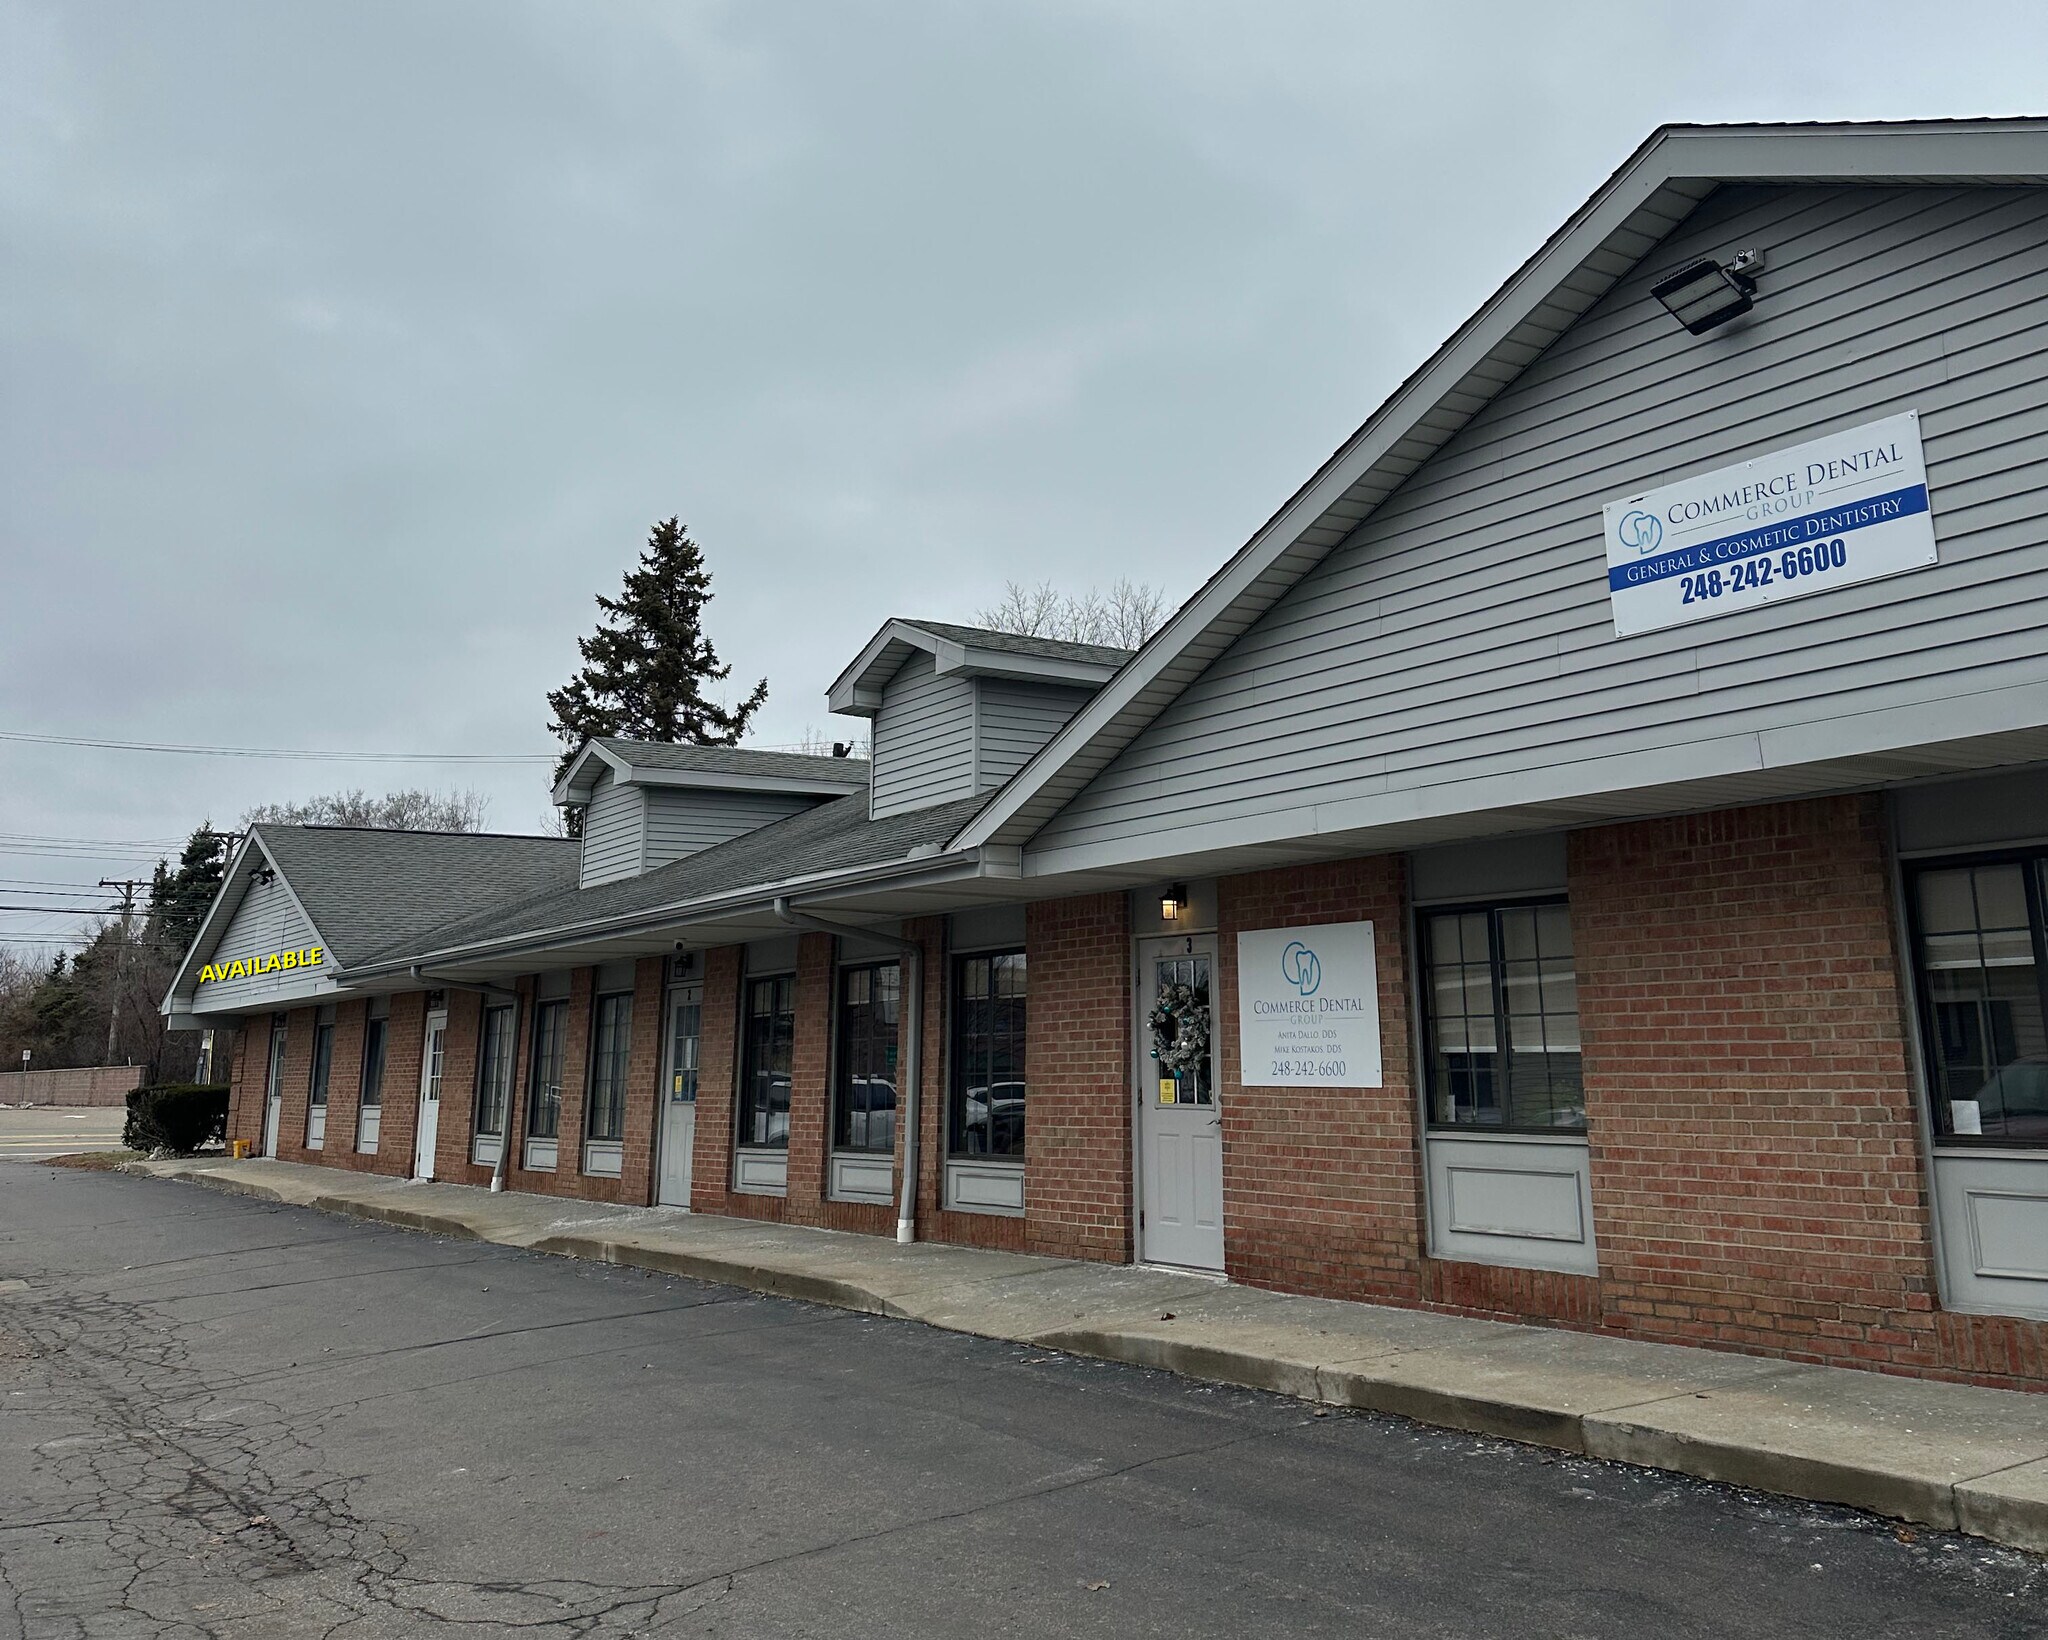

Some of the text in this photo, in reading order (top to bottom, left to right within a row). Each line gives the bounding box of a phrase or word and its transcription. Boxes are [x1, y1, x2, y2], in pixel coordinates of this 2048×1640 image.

[1668, 443, 1903, 524] COMMERCE DENTAL
[1746, 489, 1815, 520] GROUP
[1627, 498, 1903, 582] GENERAL & COSMETIC DENTISTRY
[1680, 538, 1847, 604] 248-242-6600
[1186, 936, 1193, 954] 3
[1254, 998, 1364, 1014] COMMERCE DENTAL
[1290, 1014, 1323, 1025] GROUP
[1321, 1029, 1337, 1039] DDS
[1326, 1044, 1342, 1053] DDS
[1271, 1060, 1346, 1077] 248-242-6600
